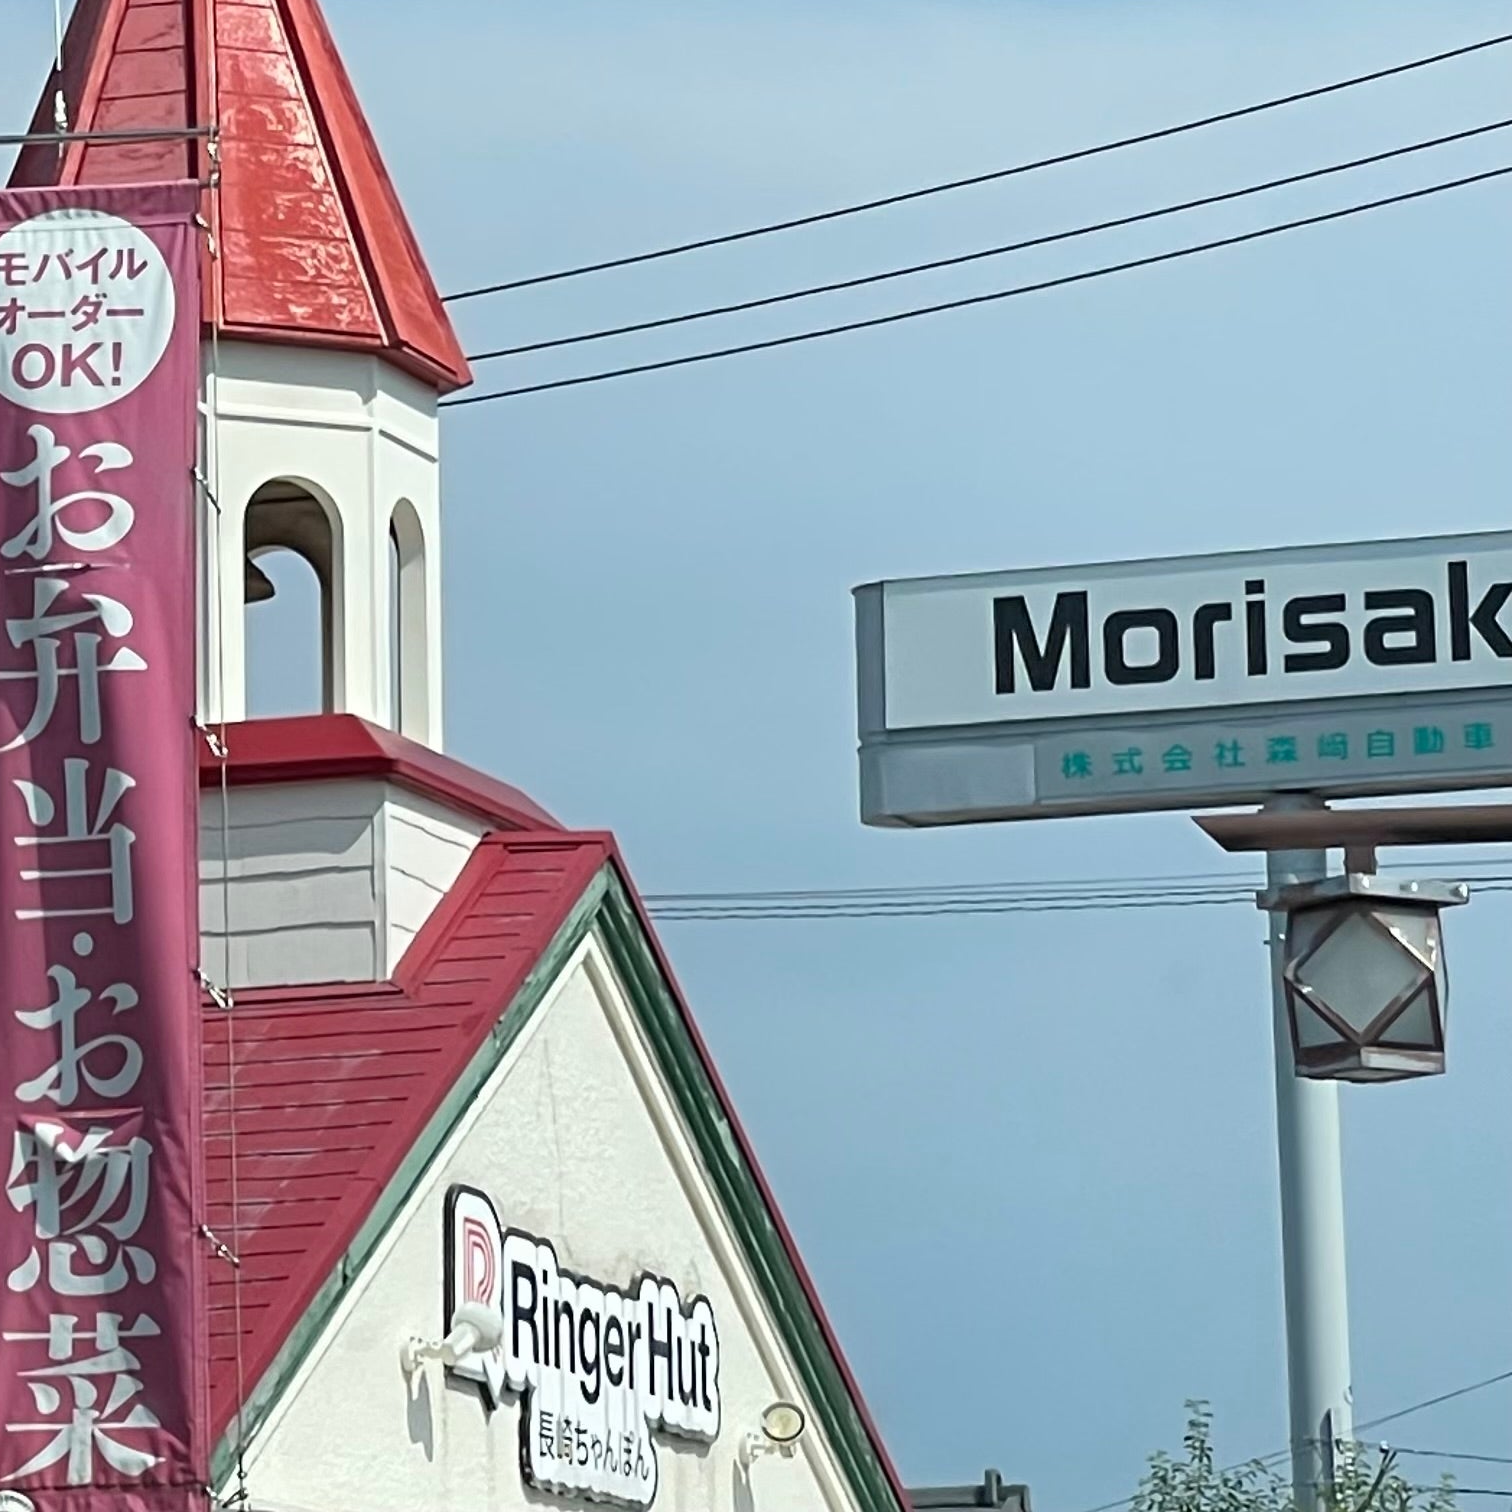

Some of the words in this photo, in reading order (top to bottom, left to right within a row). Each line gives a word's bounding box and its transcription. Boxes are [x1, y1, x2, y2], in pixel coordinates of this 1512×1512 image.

[11, 342, 122, 390] OK!
[993, 560, 1512, 695] Morisak
[539, 1409, 650, 1481] 長崎ちゃんぽん
